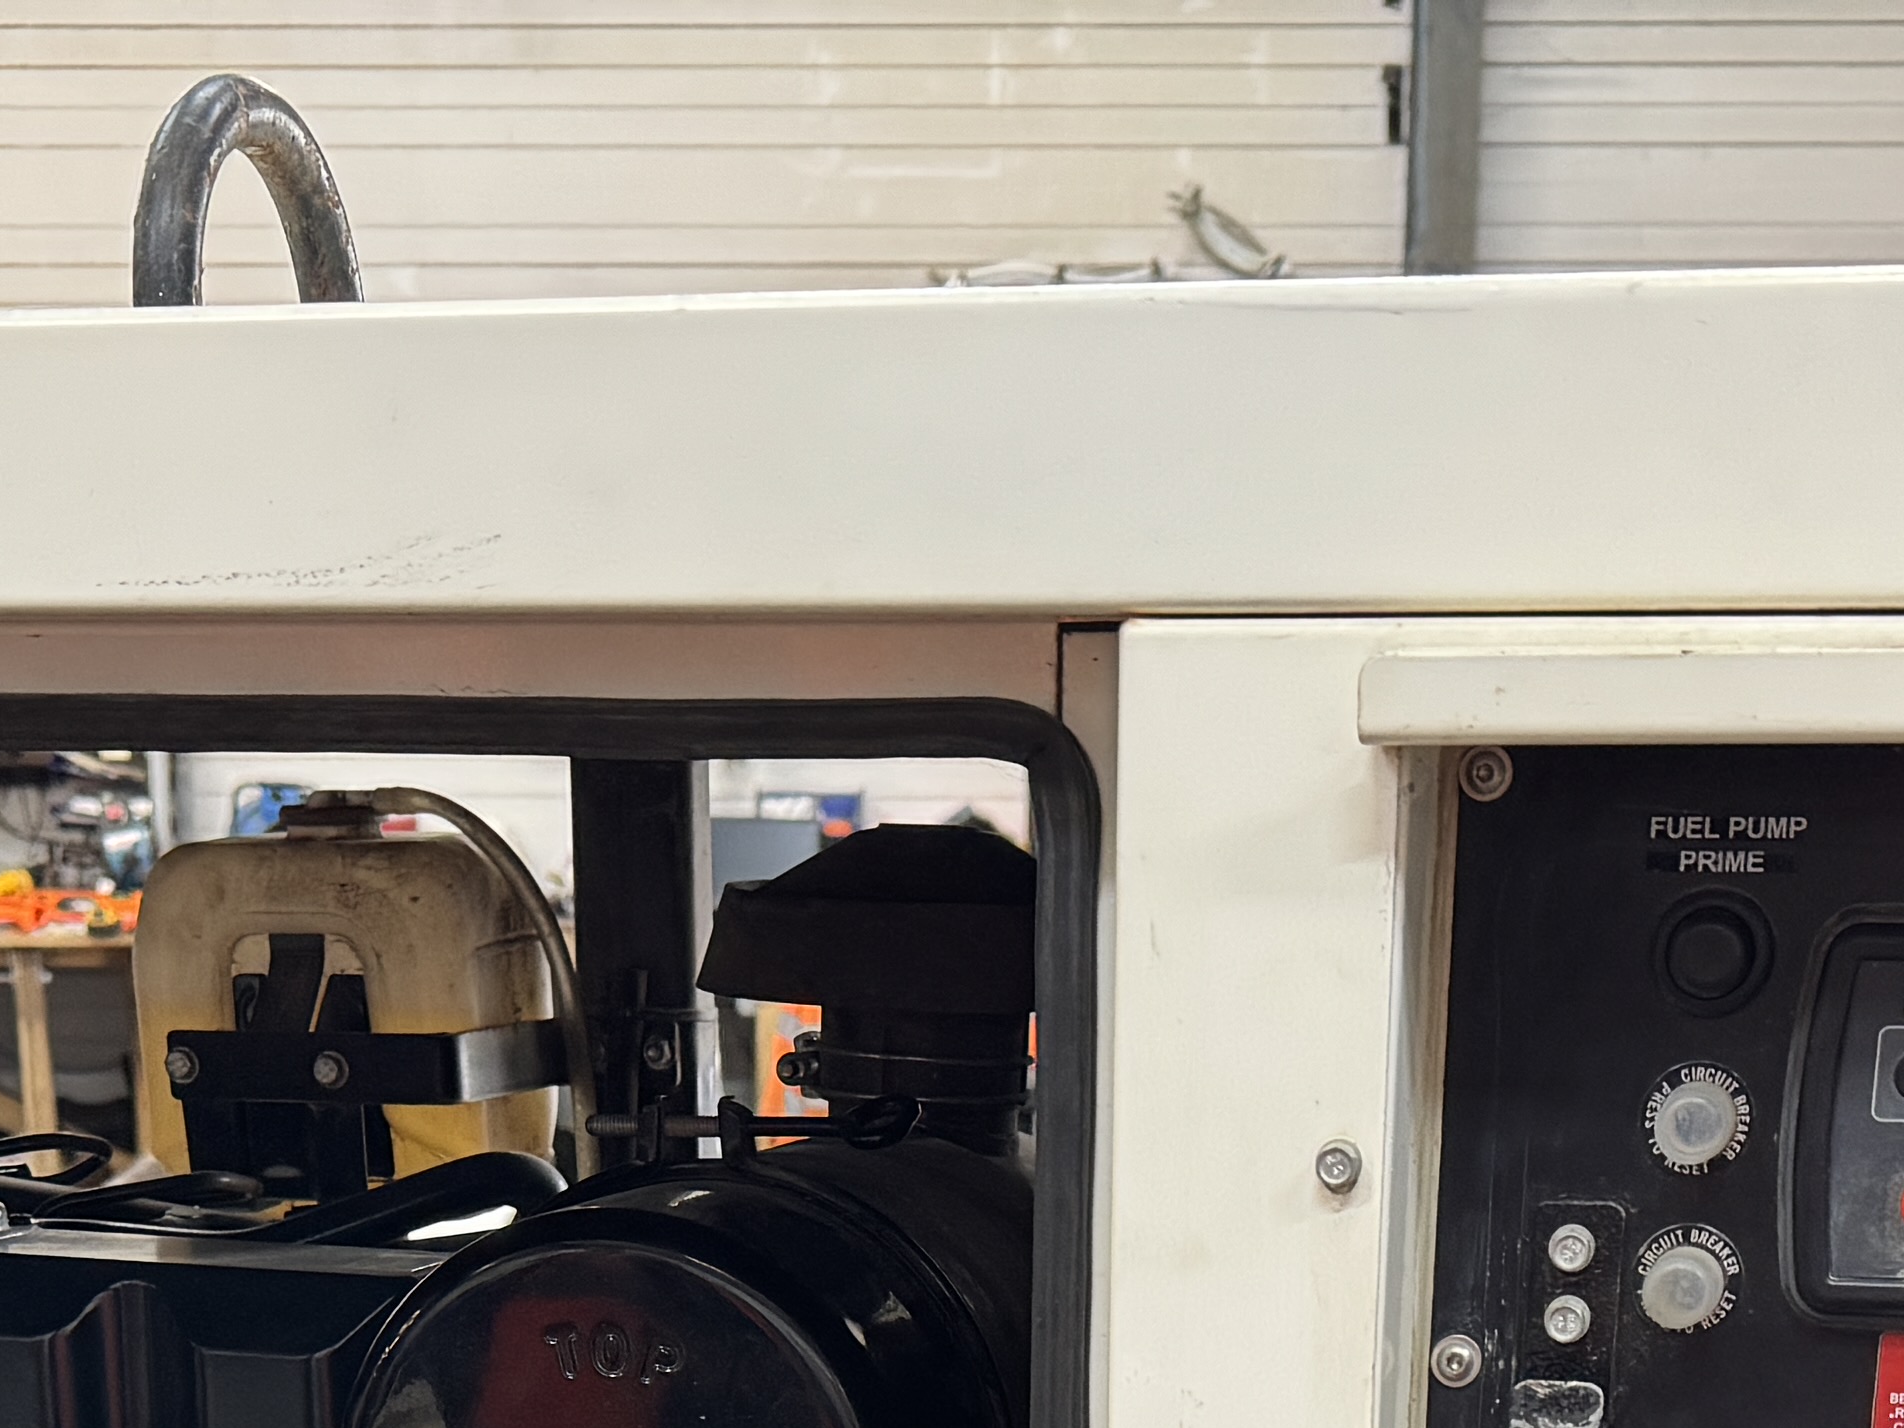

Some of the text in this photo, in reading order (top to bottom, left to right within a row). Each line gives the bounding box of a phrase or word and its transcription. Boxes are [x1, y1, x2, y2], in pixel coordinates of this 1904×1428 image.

[1650, 816, 1808, 839] FUEL PUMP
[1679, 850, 1765, 872] PRIME
[1680, 1066, 1750, 1161] CIRCUIT BREAKER
[1638, 1228, 1740, 1277] CIRCUIT BREAKER
[543, 1321, 686, 1386] TOP
